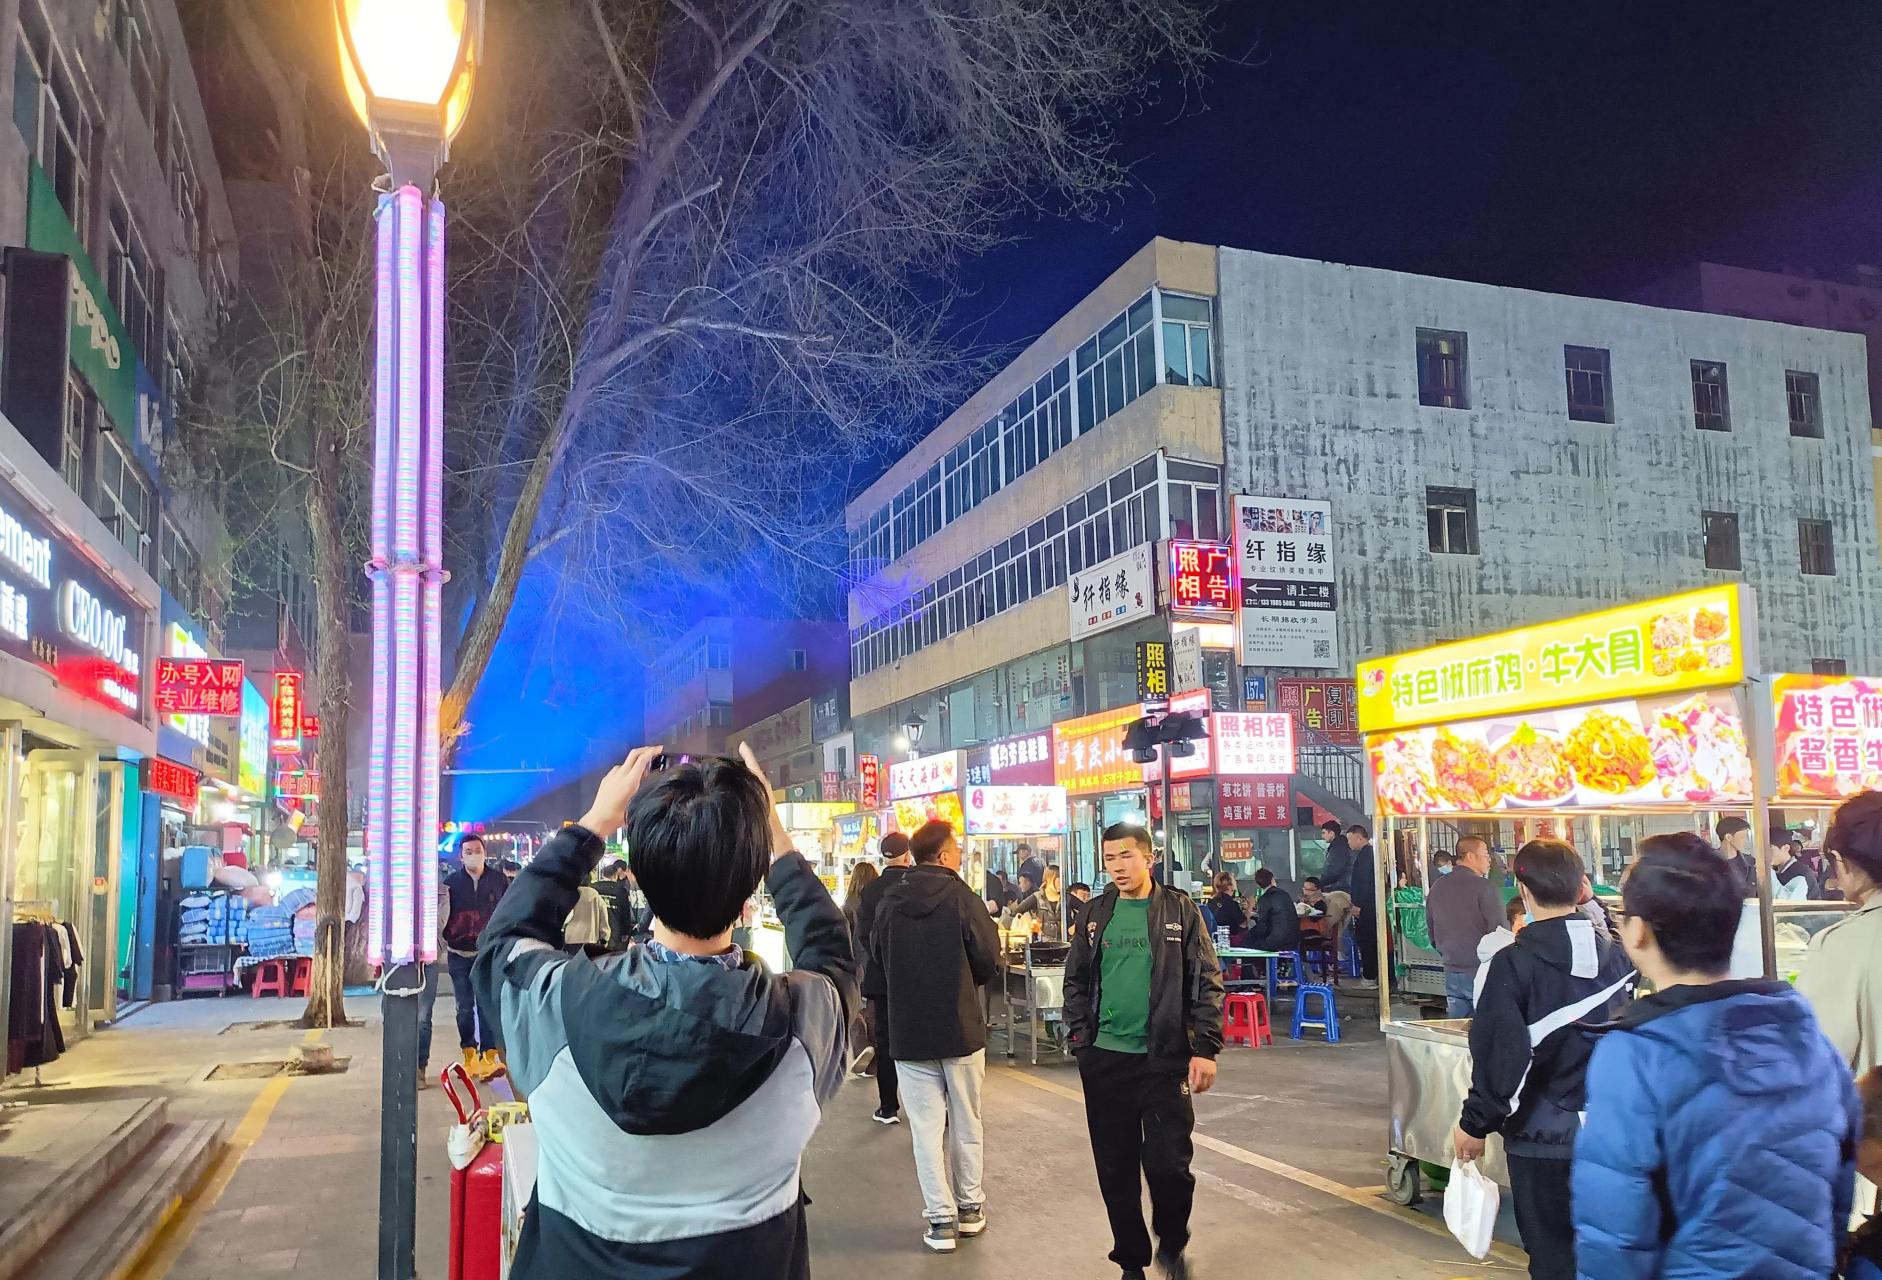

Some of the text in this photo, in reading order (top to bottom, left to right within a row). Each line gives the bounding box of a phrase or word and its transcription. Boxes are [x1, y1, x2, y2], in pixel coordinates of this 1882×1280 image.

[1246, 539, 1327, 563] 纤指缘
[1178, 548, 1200, 599] 照相
[1206, 549, 1229, 600] 广告
[1286, 584, 1329, 598] 请上二楼
[161, 662, 241, 688] 办号入网
[1146, 643, 1167, 693] 照相
[159, 688, 239, 712] 专业维修
[1304, 686, 1323, 729] 广告
[1327, 686, 1345, 728] 复印
[1220, 715, 1286, 738] 照相馆
[280, 775, 320, 796] 牛肉
[1222, 782, 1286, 797] 葱花饼 酱香饼
[1223, 805, 1252, 821] 鸡蛋饼
